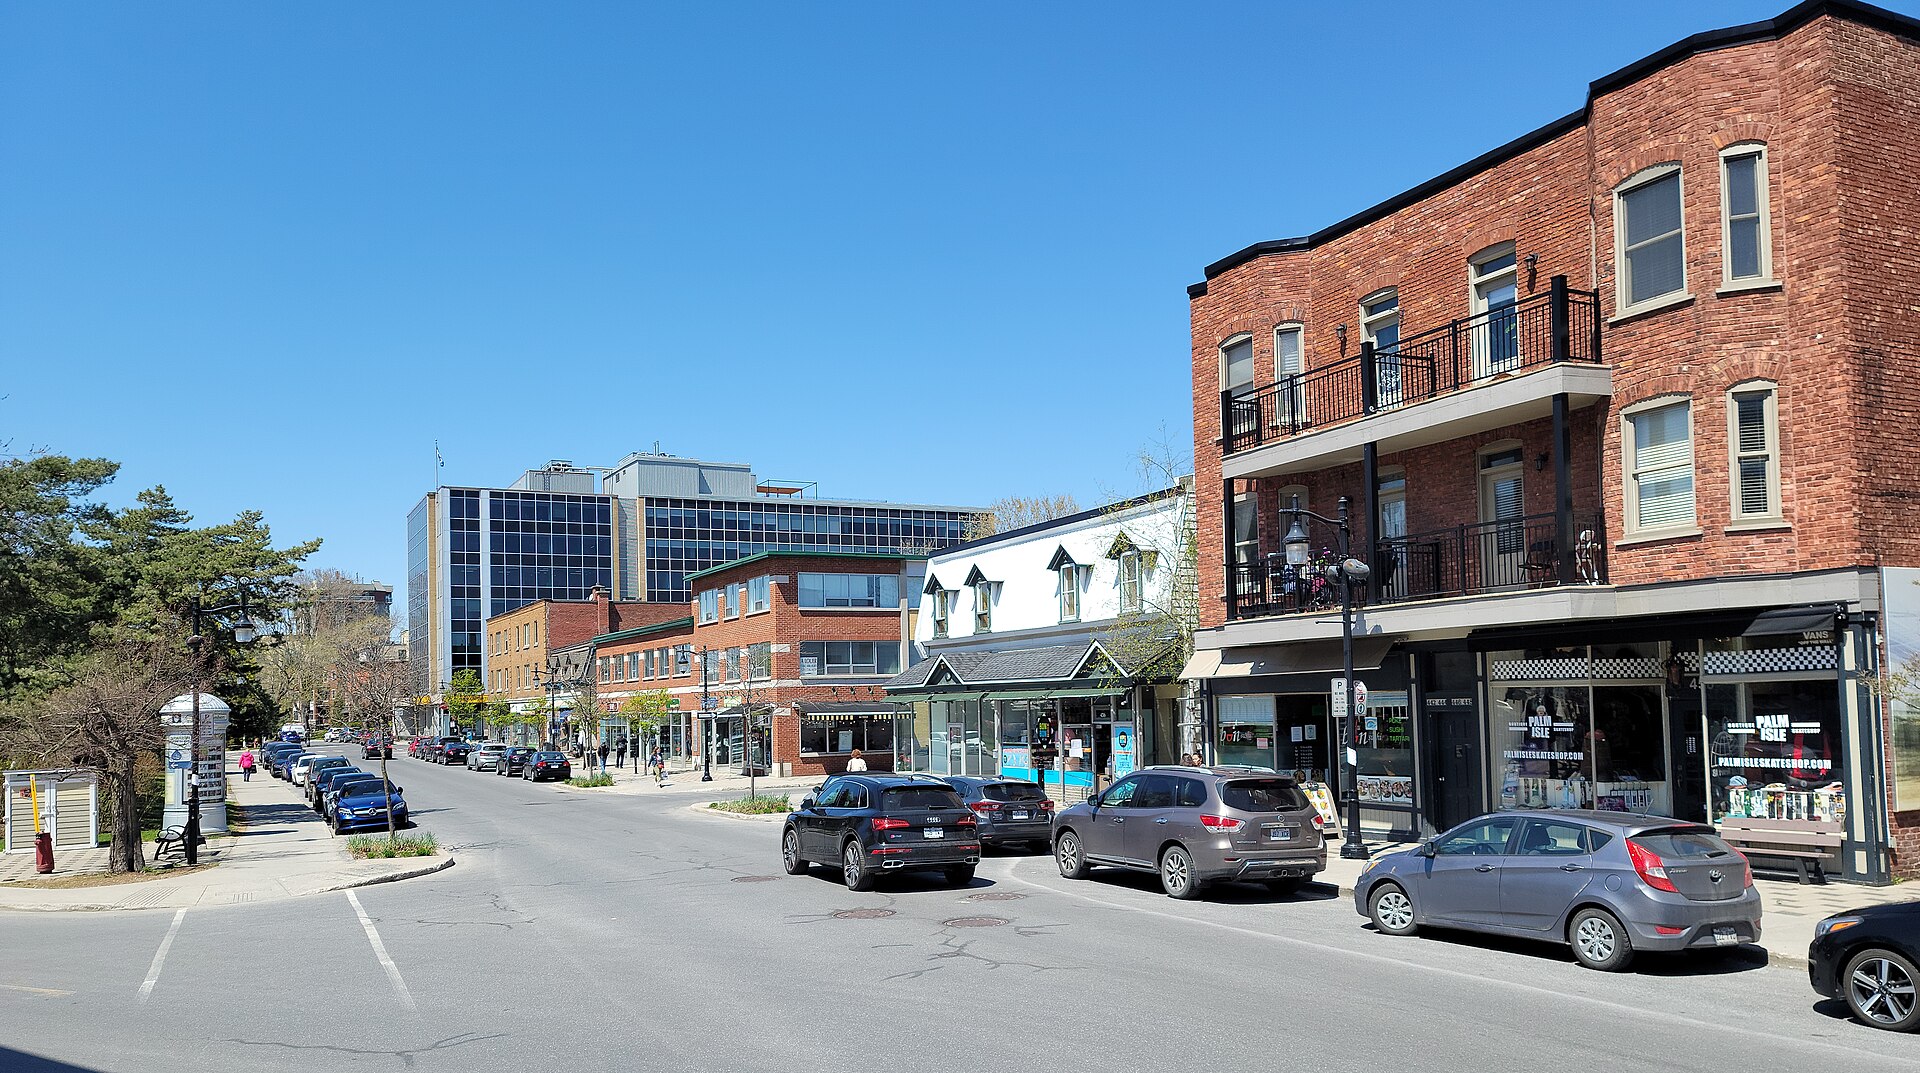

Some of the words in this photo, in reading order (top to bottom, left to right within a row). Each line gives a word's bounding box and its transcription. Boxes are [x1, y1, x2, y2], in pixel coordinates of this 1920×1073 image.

[1803, 631, 1829, 640] VANS
[1337, 681, 1343, 689] P
[1528, 715, 1552, 727] PALM
[1755, 714, 1790, 729] PALM
[1531, 726, 1550, 738] ISLE
[1760, 728, 1787, 742] ISLE
[1504, 750, 1584, 760] PALMISLESKATESHOP.COM
[1718, 757, 1832, 769] PALMISLESKATESHOP.COM
